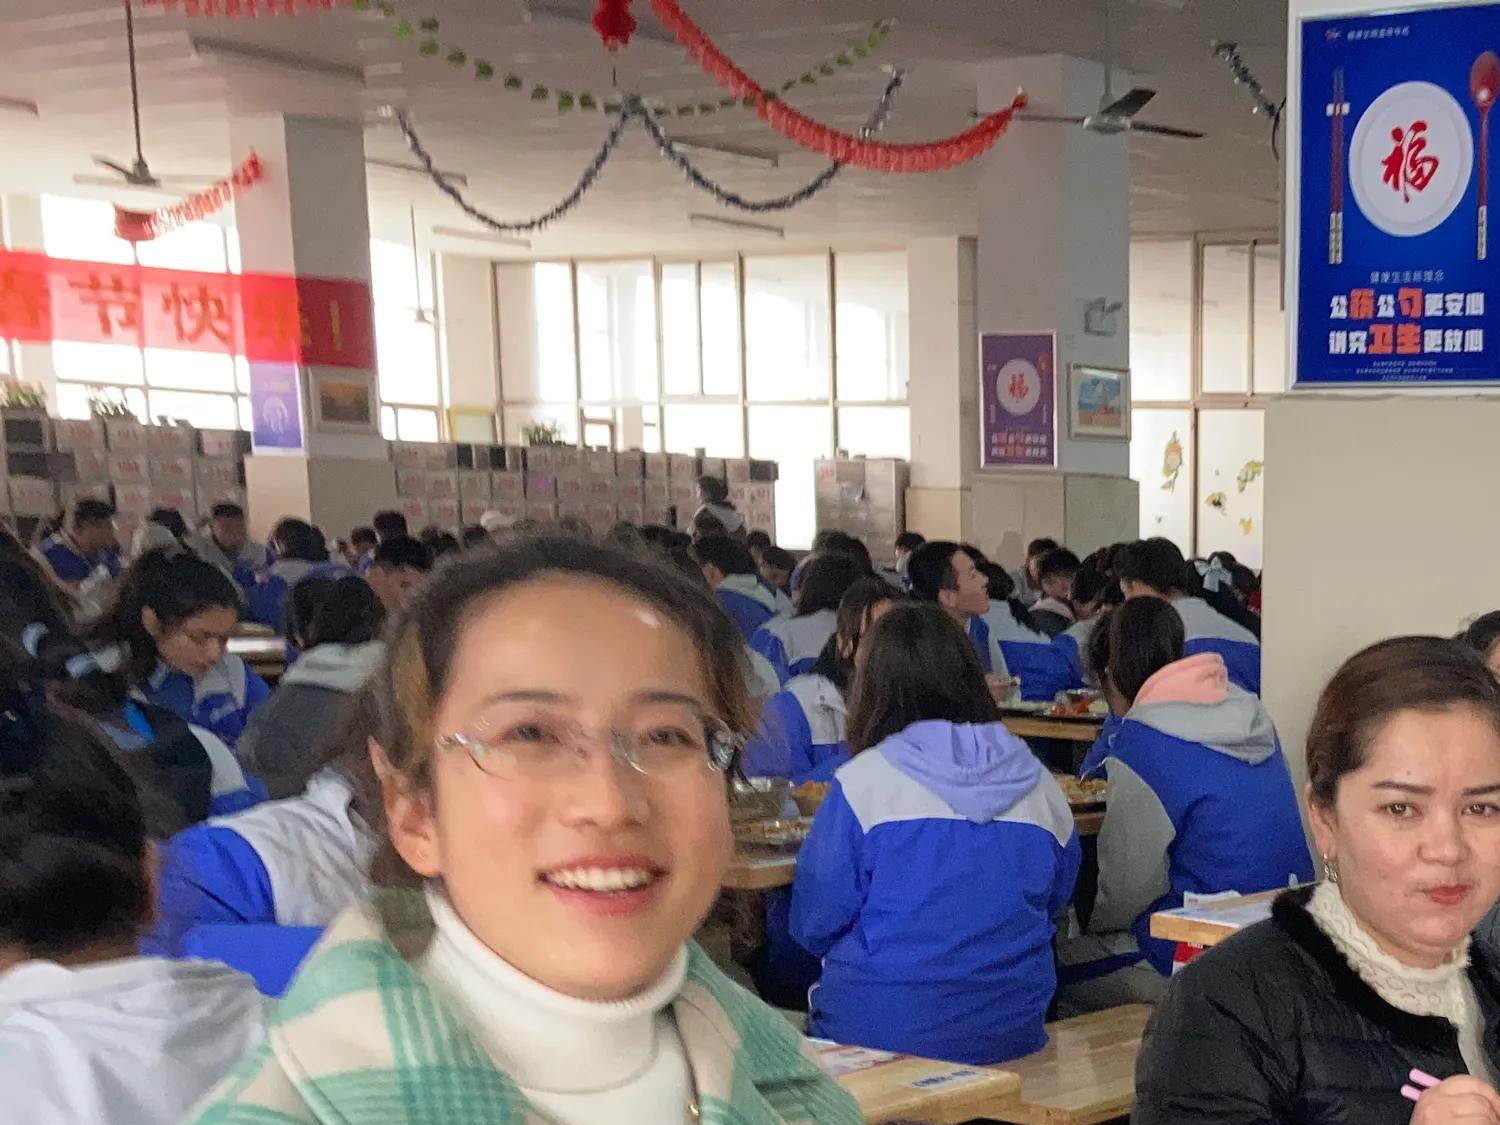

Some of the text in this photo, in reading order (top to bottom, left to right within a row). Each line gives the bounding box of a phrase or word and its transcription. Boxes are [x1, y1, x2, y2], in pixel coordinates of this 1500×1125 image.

[1381, 120, 1439, 203] 福
[1329, 287, 1485, 321] 公筷公勺更安心
[1328, 322, 1484, 355] 讲究卫生更放心
